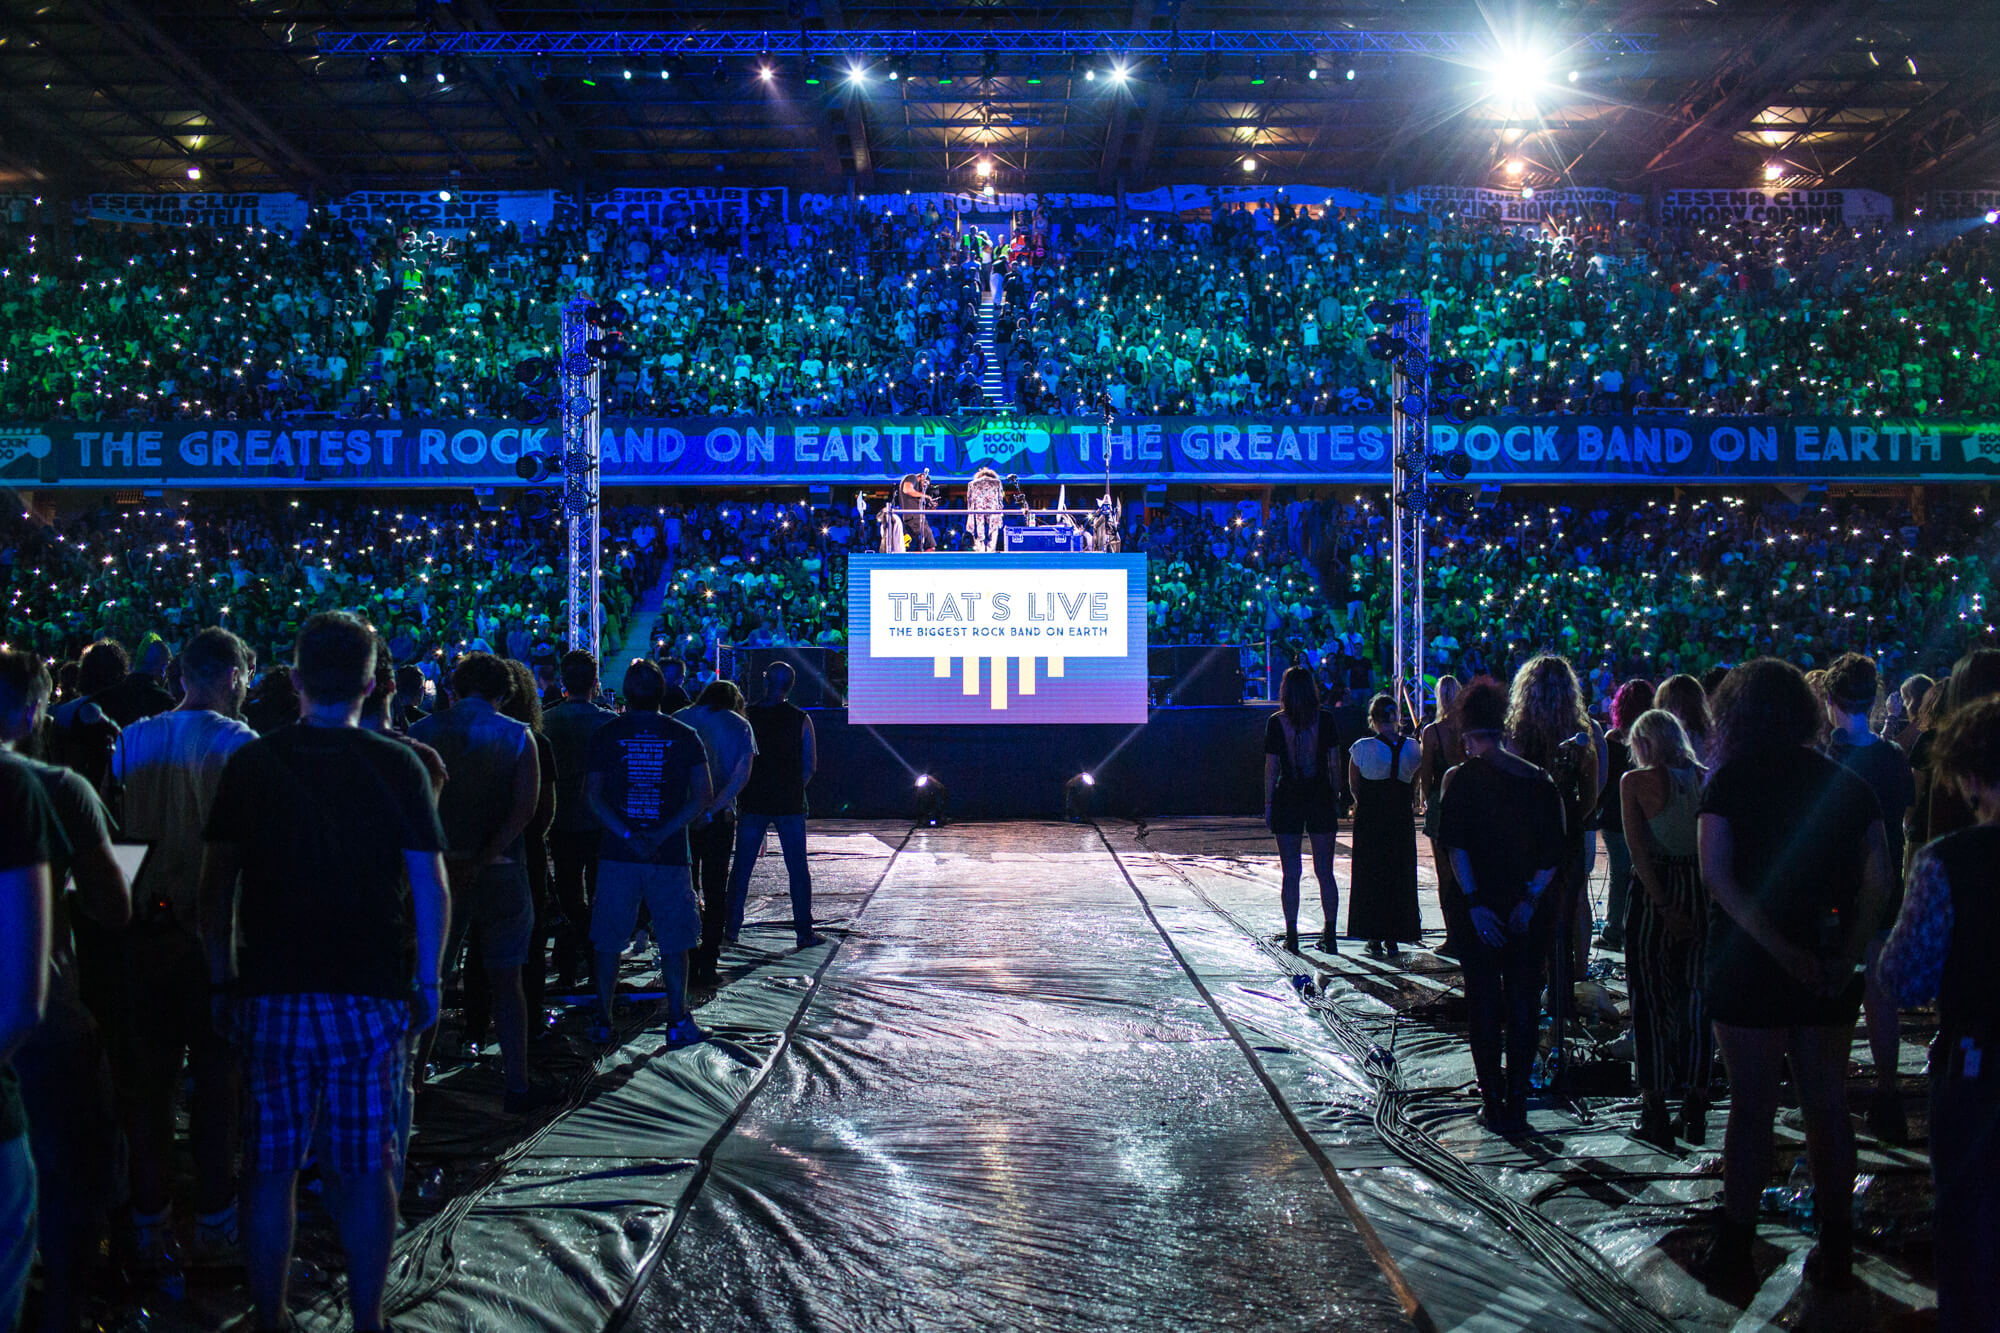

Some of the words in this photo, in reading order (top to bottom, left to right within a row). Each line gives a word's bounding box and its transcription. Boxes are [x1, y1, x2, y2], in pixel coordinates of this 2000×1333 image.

[91, 195, 181, 208] ESENA
[187, 194, 260, 208] CLUB
[428, 193, 499, 203] CUB
[554, 190, 663, 202] CSENA
[1663, 191, 1767, 205] CESENA
[1773, 191, 1844, 206] CLUB
[73, 431, 163, 467] THE
[179, 429, 402, 467] GREATEST
[420, 428, 550, 465] ROCK
[600, 427, 686, 462] AND
[705, 426, 776, 462] ON
[794, 426, 945, 462] EARTH
[984, 443, 1015, 454] 1000
[1070, 424, 1163, 461] THE
[1180, 424, 1393, 461] GREATES
[1577, 425, 1693, 463] BAND
[1709, 426, 1778, 462] ON
[1794, 425, 1942, 462] EARTH
[1028, 592, 1109, 622] LIVE
[889, 627, 913, 637] THE
[917, 627, 967, 637] BIGGEST
[972, 627, 1005, 637] ROCK
[1010, 627, 1041, 637] BAND
[1047, 627, 1064, 637] ON
[1069, 627, 1108, 637] EARTH
